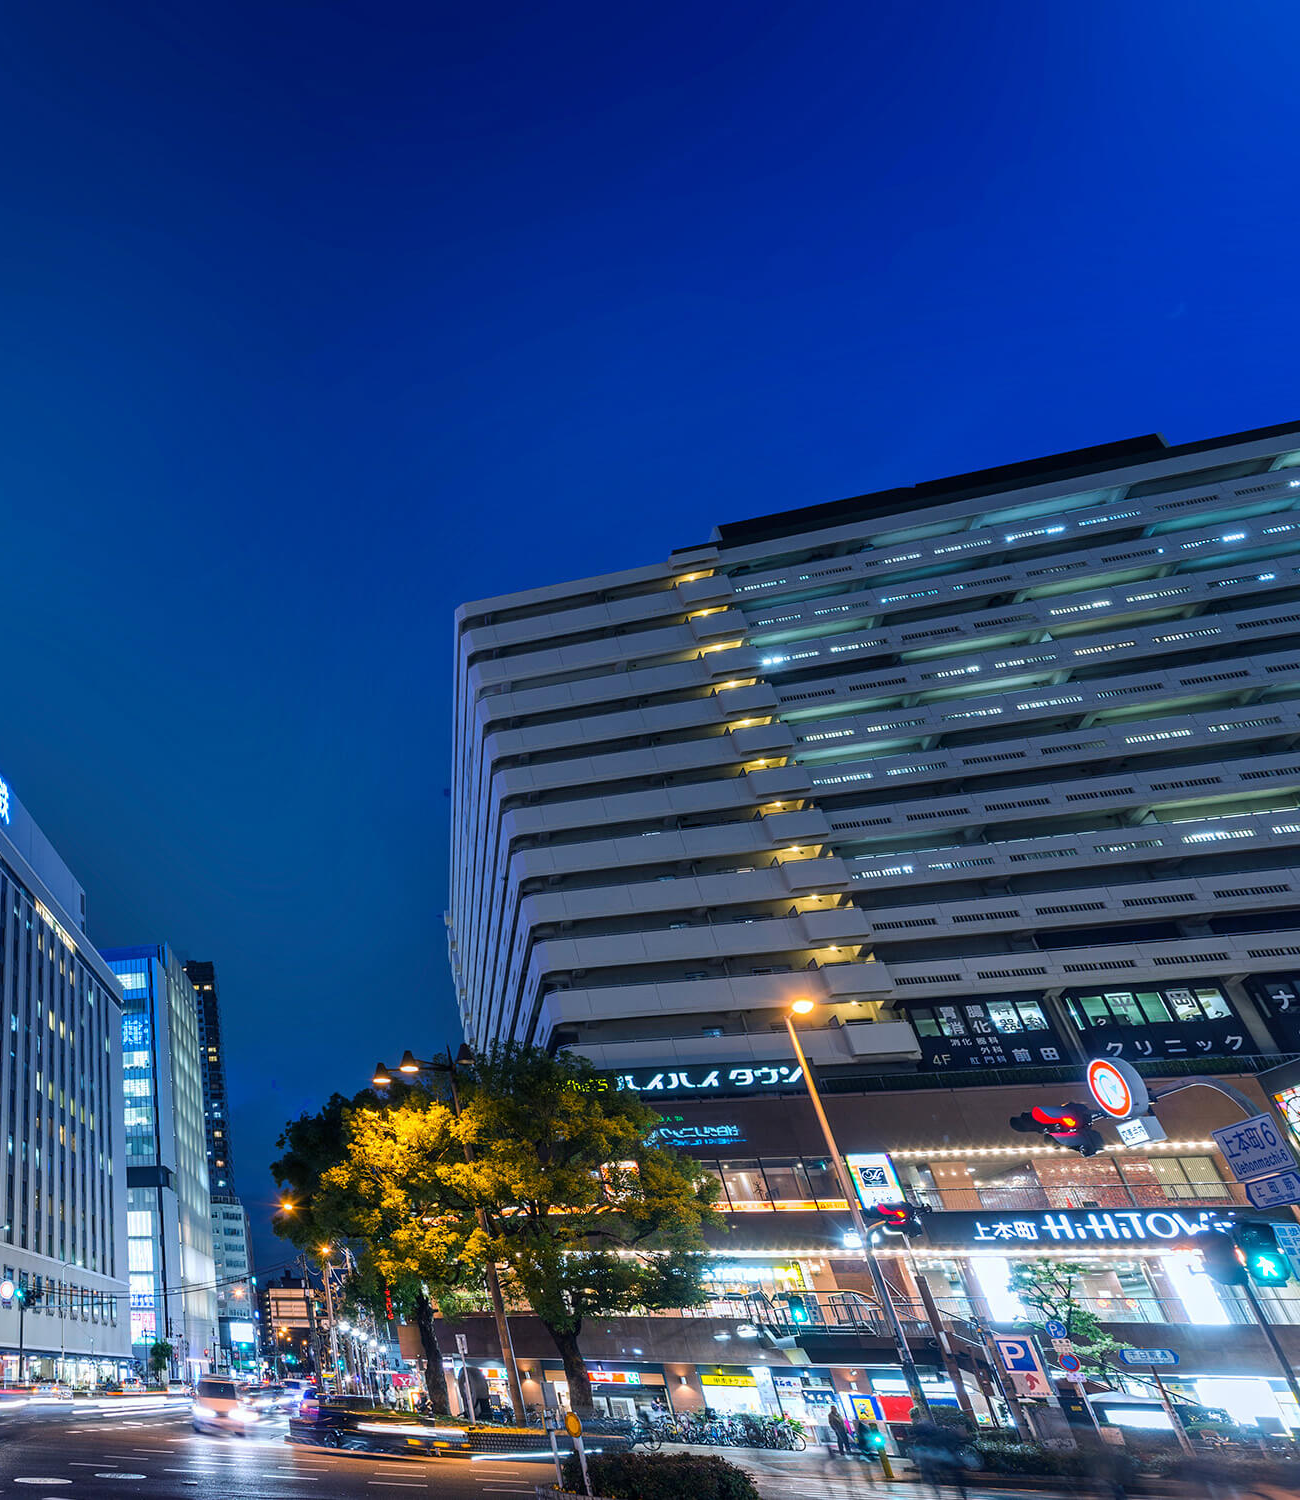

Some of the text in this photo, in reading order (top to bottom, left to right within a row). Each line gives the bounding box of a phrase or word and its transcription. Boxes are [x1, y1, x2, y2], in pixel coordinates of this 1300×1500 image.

[1106, 1035, 1243, 1056] クリニック
[933, 1054, 952, 1066] 4F
[1222, 1122, 1277, 1158] 上本町6
[973, 1221, 1038, 1241] 上本町
[998, 1342, 1025, 1369] P
